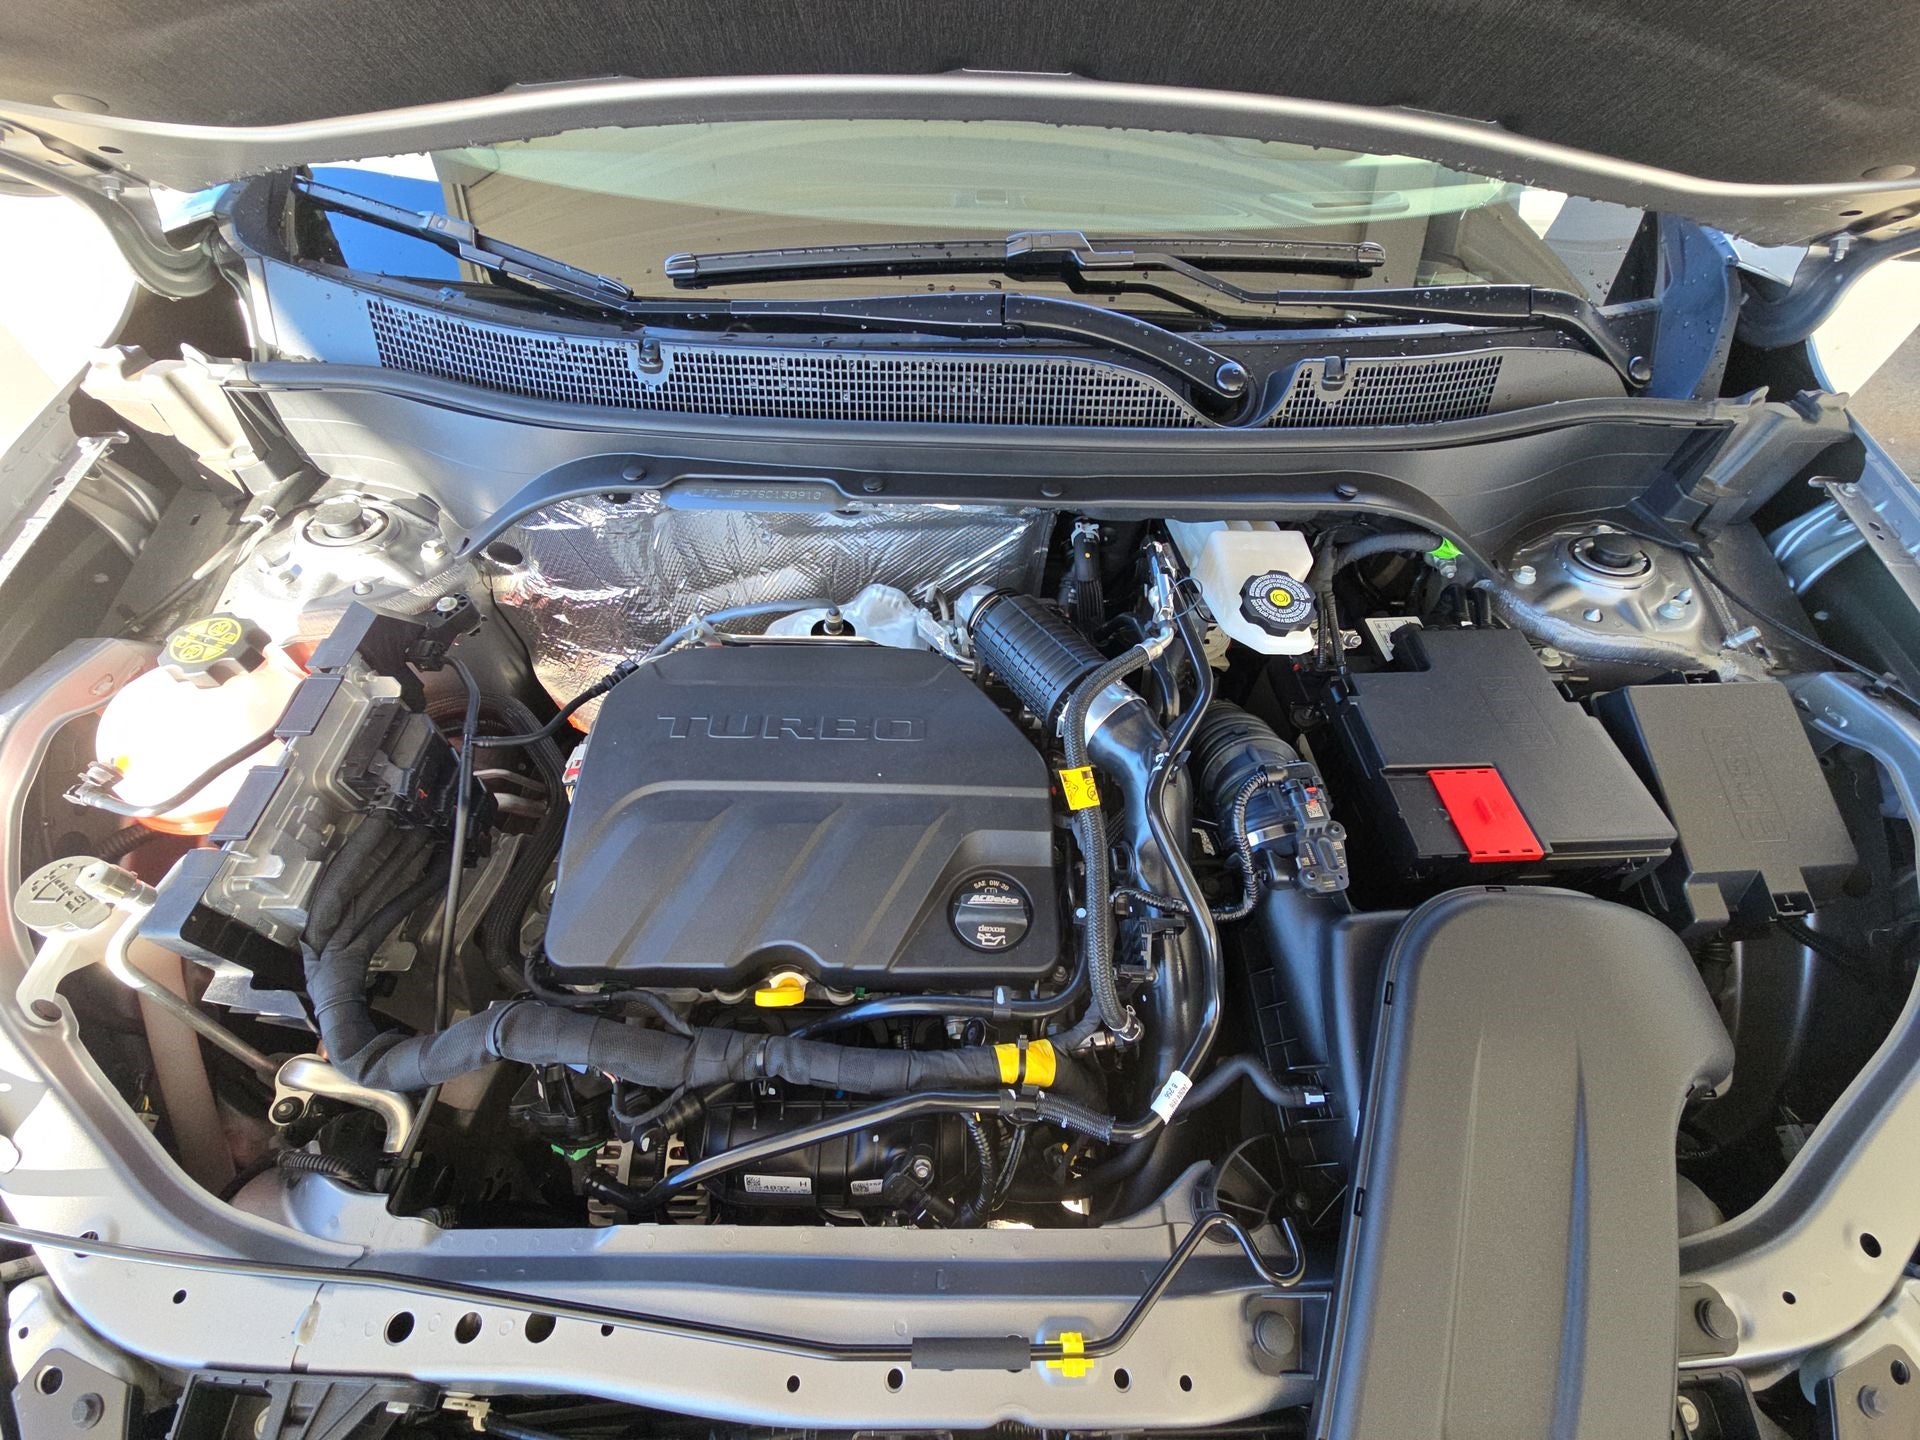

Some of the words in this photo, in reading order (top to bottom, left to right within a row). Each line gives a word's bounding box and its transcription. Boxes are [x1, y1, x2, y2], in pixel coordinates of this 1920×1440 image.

[656, 714, 926, 743] TURBO
[973, 880, 987, 889] SAE
[968, 894, 1019, 904] ACDelco
[978, 924, 1006, 932] dexos
